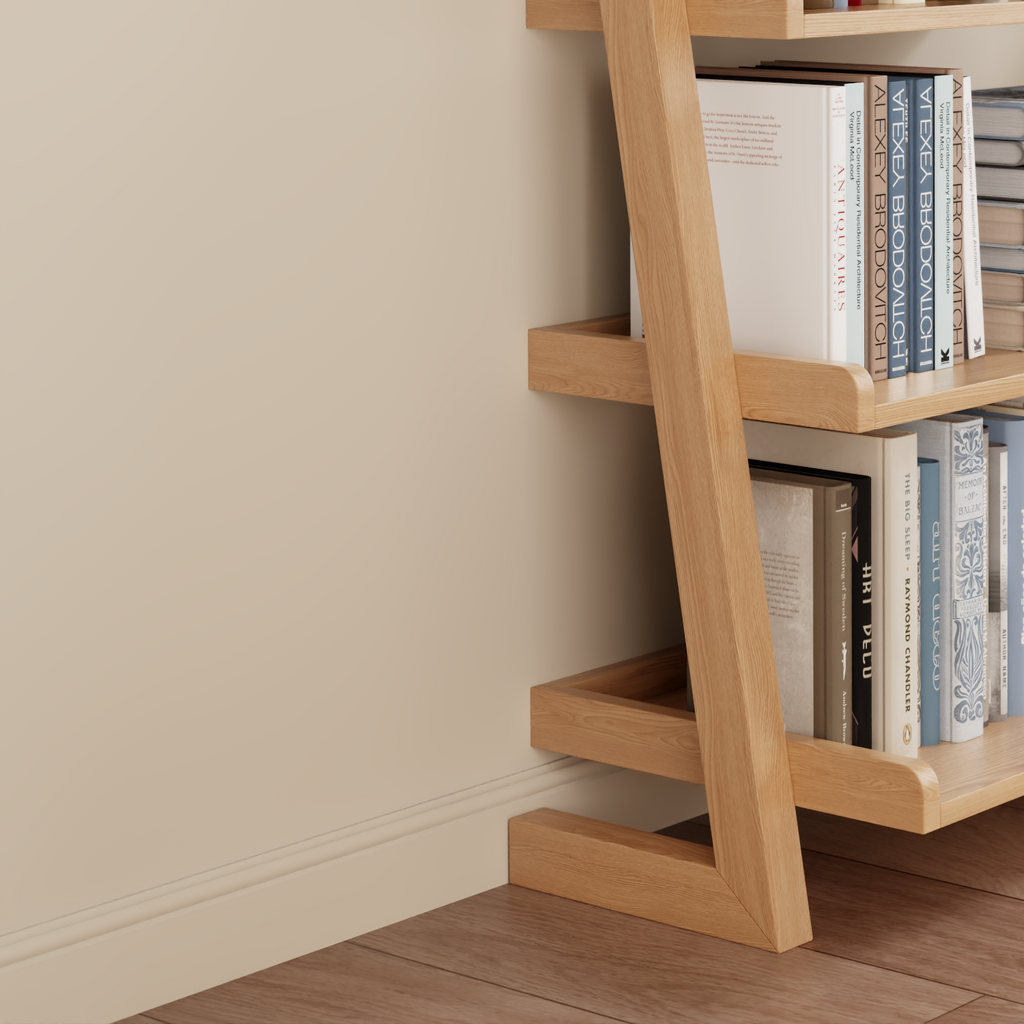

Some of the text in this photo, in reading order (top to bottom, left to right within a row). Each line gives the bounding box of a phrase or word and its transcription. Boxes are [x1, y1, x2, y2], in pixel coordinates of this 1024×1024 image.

[874, 84, 886, 183] ALEXEY
[836, 165, 846, 312] ANTIQUAIRES
[874, 193, 886, 360] BRODOVITCH
[953, 78, 962, 345] ALEXEY BRODOVITCH
[842, 582, 847, 591] of
